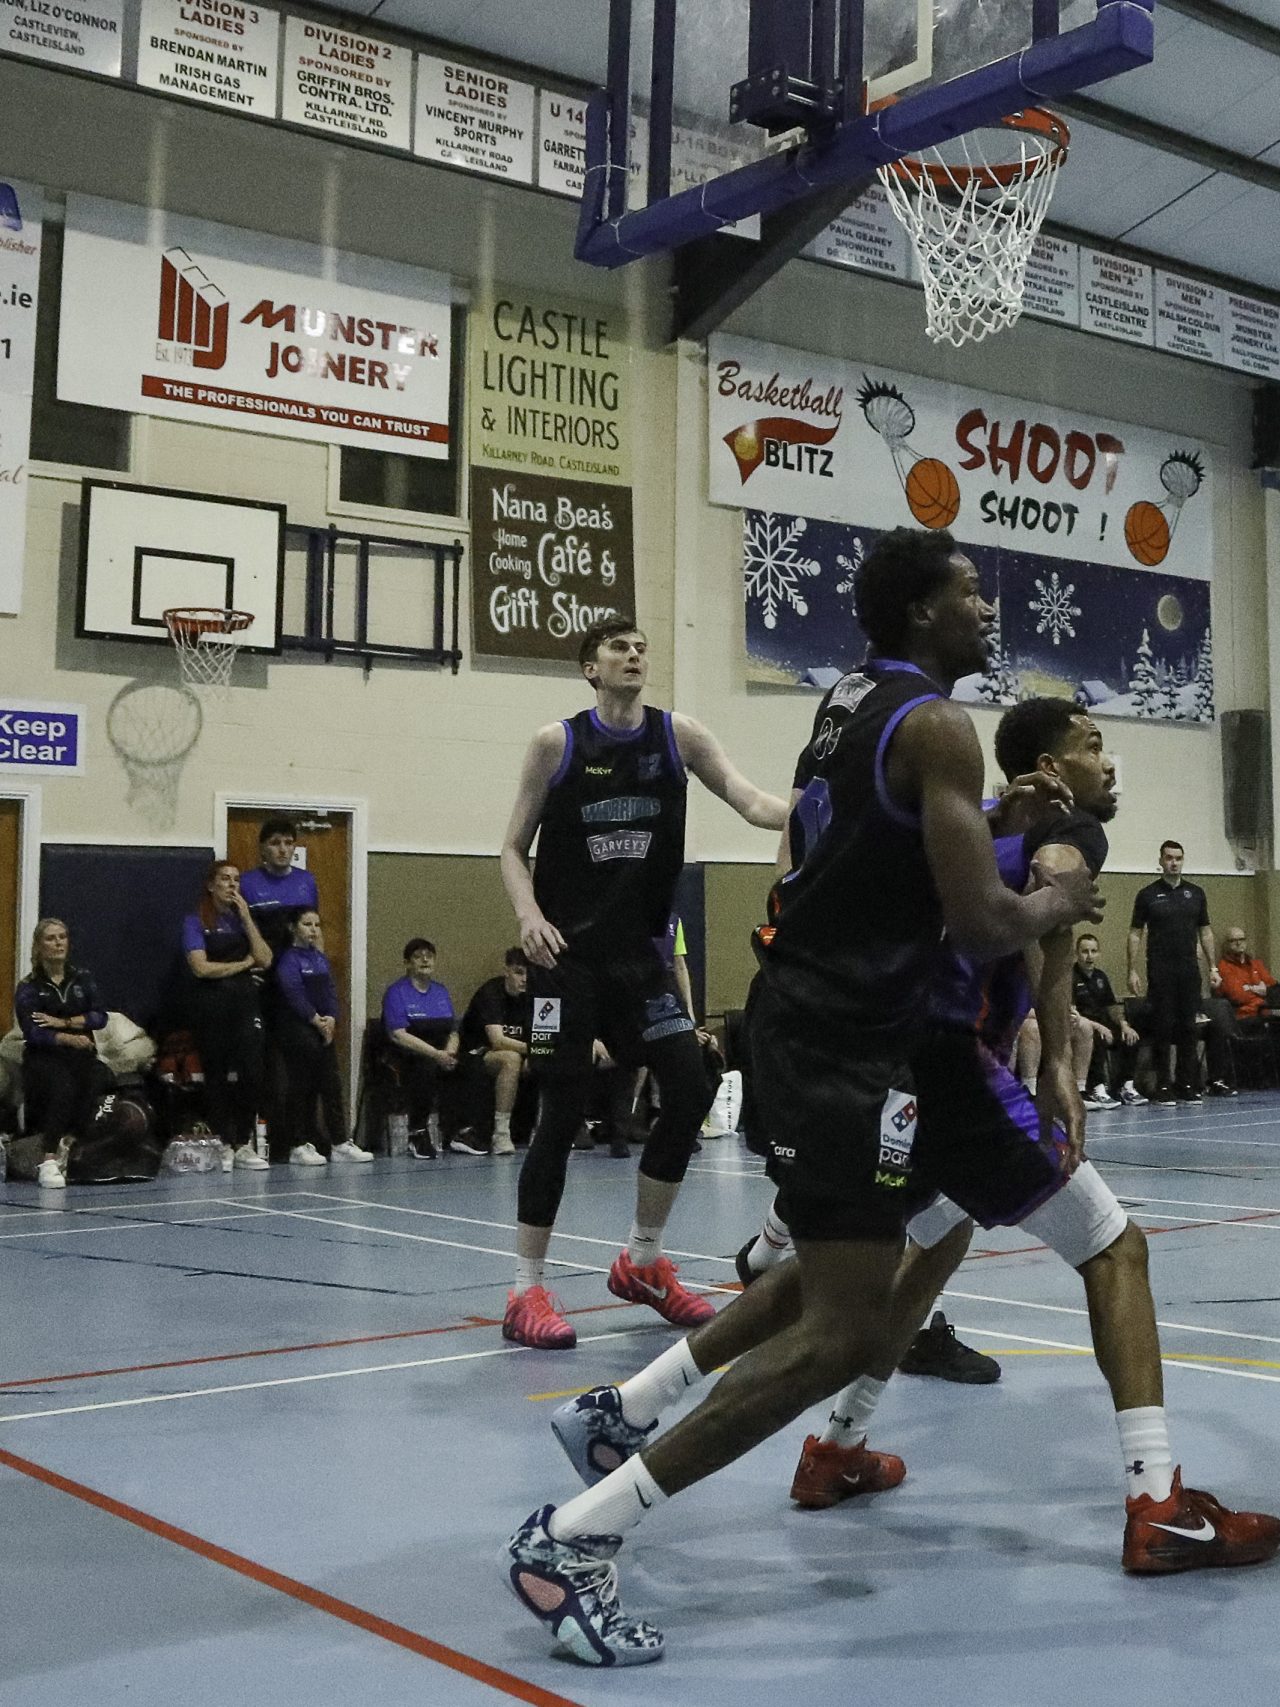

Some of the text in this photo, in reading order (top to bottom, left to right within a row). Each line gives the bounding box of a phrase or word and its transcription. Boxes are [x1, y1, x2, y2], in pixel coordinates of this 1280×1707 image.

[52, 6, 118, 33] O'CONNOR
[179, 7, 246, 36] LADIES
[248, 9, 260, 24] 3
[9, 29, 86, 56] CASTLEISLAND
[174, 28, 245, 53] SPONSORED BY
[303, 25, 392, 60] DIVISION 2
[150, 35, 268, 78] BRENDAN MARTIN
[319, 44, 376, 70] LADIES
[174, 62, 242, 90] IRISH GAS
[298, 56, 392, 88] SPONSORED BY
[443, 65, 509, 95] SENIOR
[159, 72, 256, 107] MANAGEMENT
[297, 70, 396, 106] GRIFFIN BROS.
[298, 83, 392, 118] CONTRA. LTD.
[445, 81, 508, 109] LADIES
[305, 101, 367, 124] KILLARNEY
[448, 98, 496, 118] SPONSORED
[550, 102, 585, 125] U 14
[303, 111, 389, 139] CASTLEISLAND
[425, 103, 525, 142] VINCENT MURPHY
[453, 125, 497, 147] SPORTS
[435, 137, 514, 165] KILLARNEY ROAD
[440, 148, 508, 173] CALEISLAND
[829, 222, 855, 239] PAUL
[1092, 255, 1136, 276] DIVISION
[1100, 268, 1122, 283] MEN
[0, 284, 33, 309] .ie
[1090, 280, 1134, 298] SPONSORED
[1165, 276, 1215, 301] DIVISION 2
[1180, 292, 1202, 306] MEN
[1085, 292, 1151, 317] CASTLEISLAND
[1088, 304, 1148, 329] TYRE CENTRE
[1263, 305, 1280, 320] MEN
[240, 298, 440, 361] MUNSTER
[493, 300, 610, 361] CASTLE
[1177, 323, 1202, 338] PRINT
[1187, 316, 1221, 334] COLOUR
[483, 349, 620, 412] LIGHTING
[716, 360, 844, 418] Basketball
[162, 382, 431, 438] THE PROFESSIONALS YOU CAN TRUST
[481, 404, 620, 451] & INTERIORS
[764, 438, 835, 479] BLITZ
[955, 408, 1126, 496] SHOOT
[491, 483, 614, 531] Nana Bea's
[979, 490, 1080, 537] SHOOT
[492, 527, 528, 551] Home
[489, 551, 532, 581] Cooking
[537, 532, 616, 587] Café &
[489, 585, 540, 634] Gift
[0, 713, 67, 742] Keep
[0, 738, 68, 762] Clear
